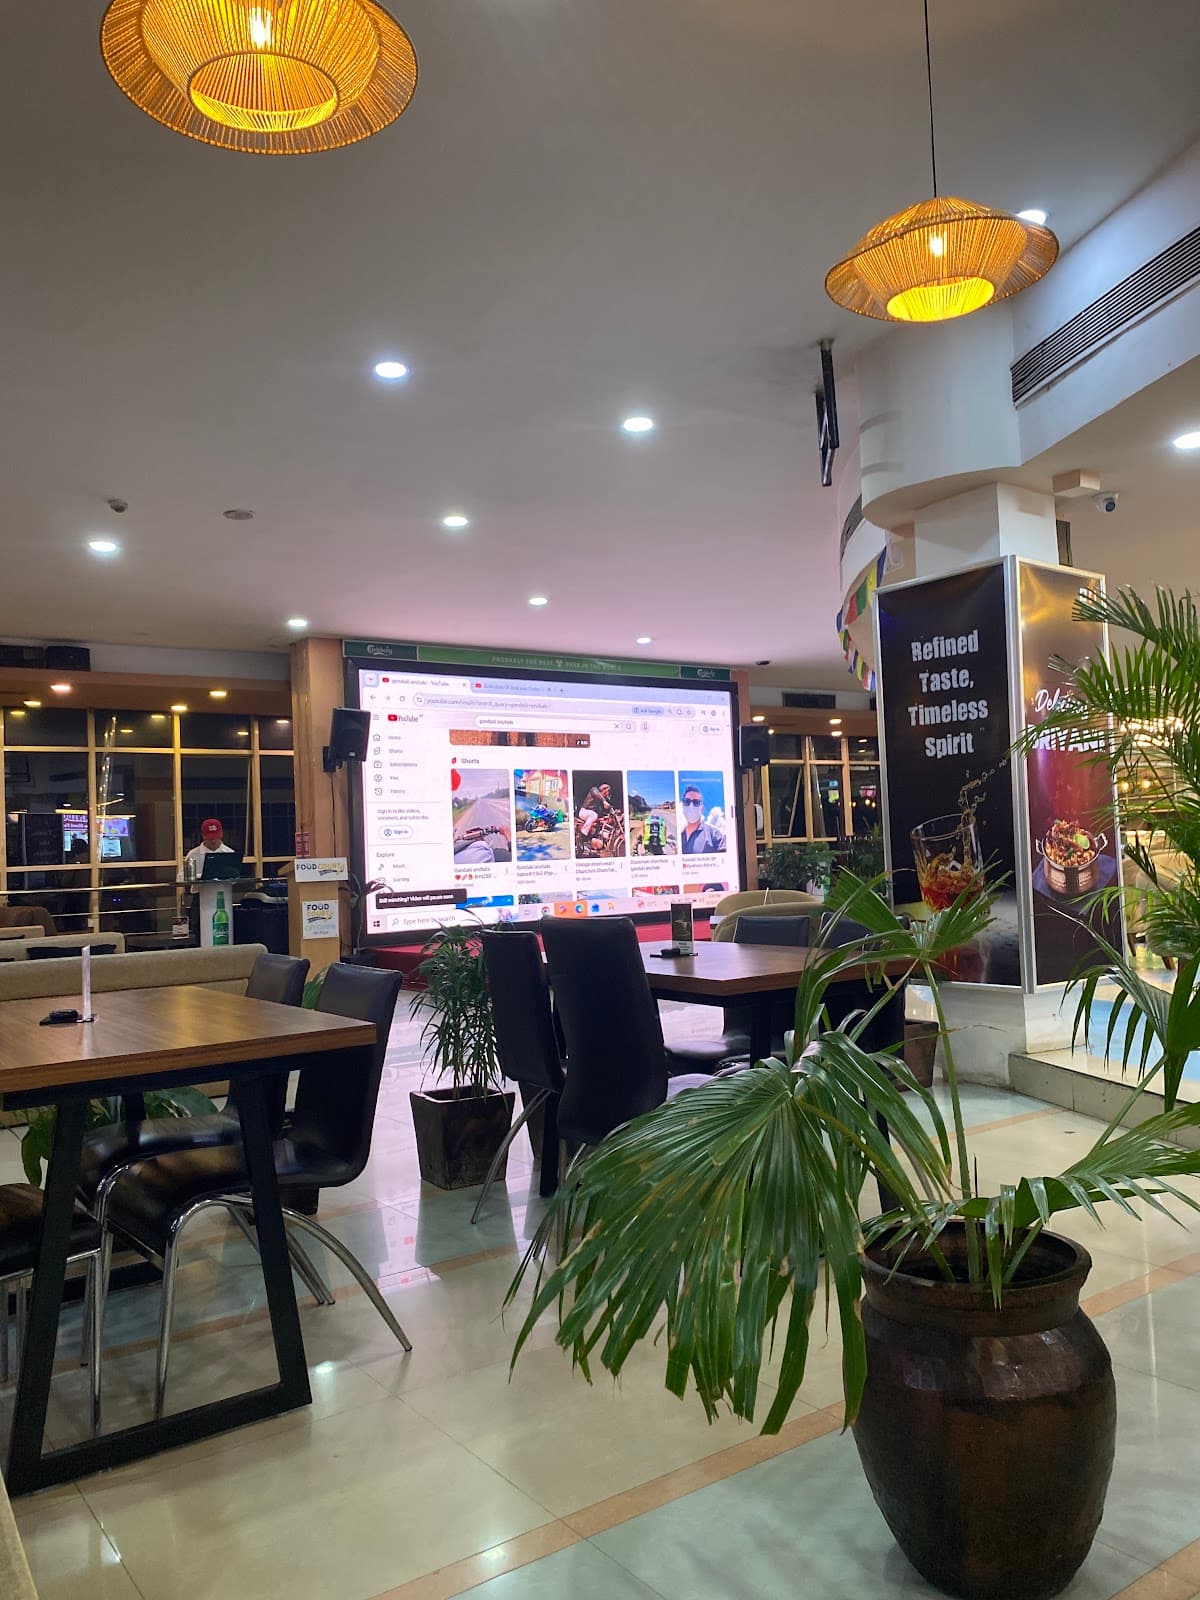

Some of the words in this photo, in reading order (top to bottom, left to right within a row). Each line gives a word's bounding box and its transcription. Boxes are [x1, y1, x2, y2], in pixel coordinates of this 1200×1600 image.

[911, 630, 979, 662] Refined
[919, 668, 974, 693] Taste,
[907, 700, 989, 727] Timeless
[925, 733, 975, 759] Spirit
[296, 863, 317, 871] FOOD
[306, 903, 330, 911] FOOD
[403, 918, 415, 926] Type
